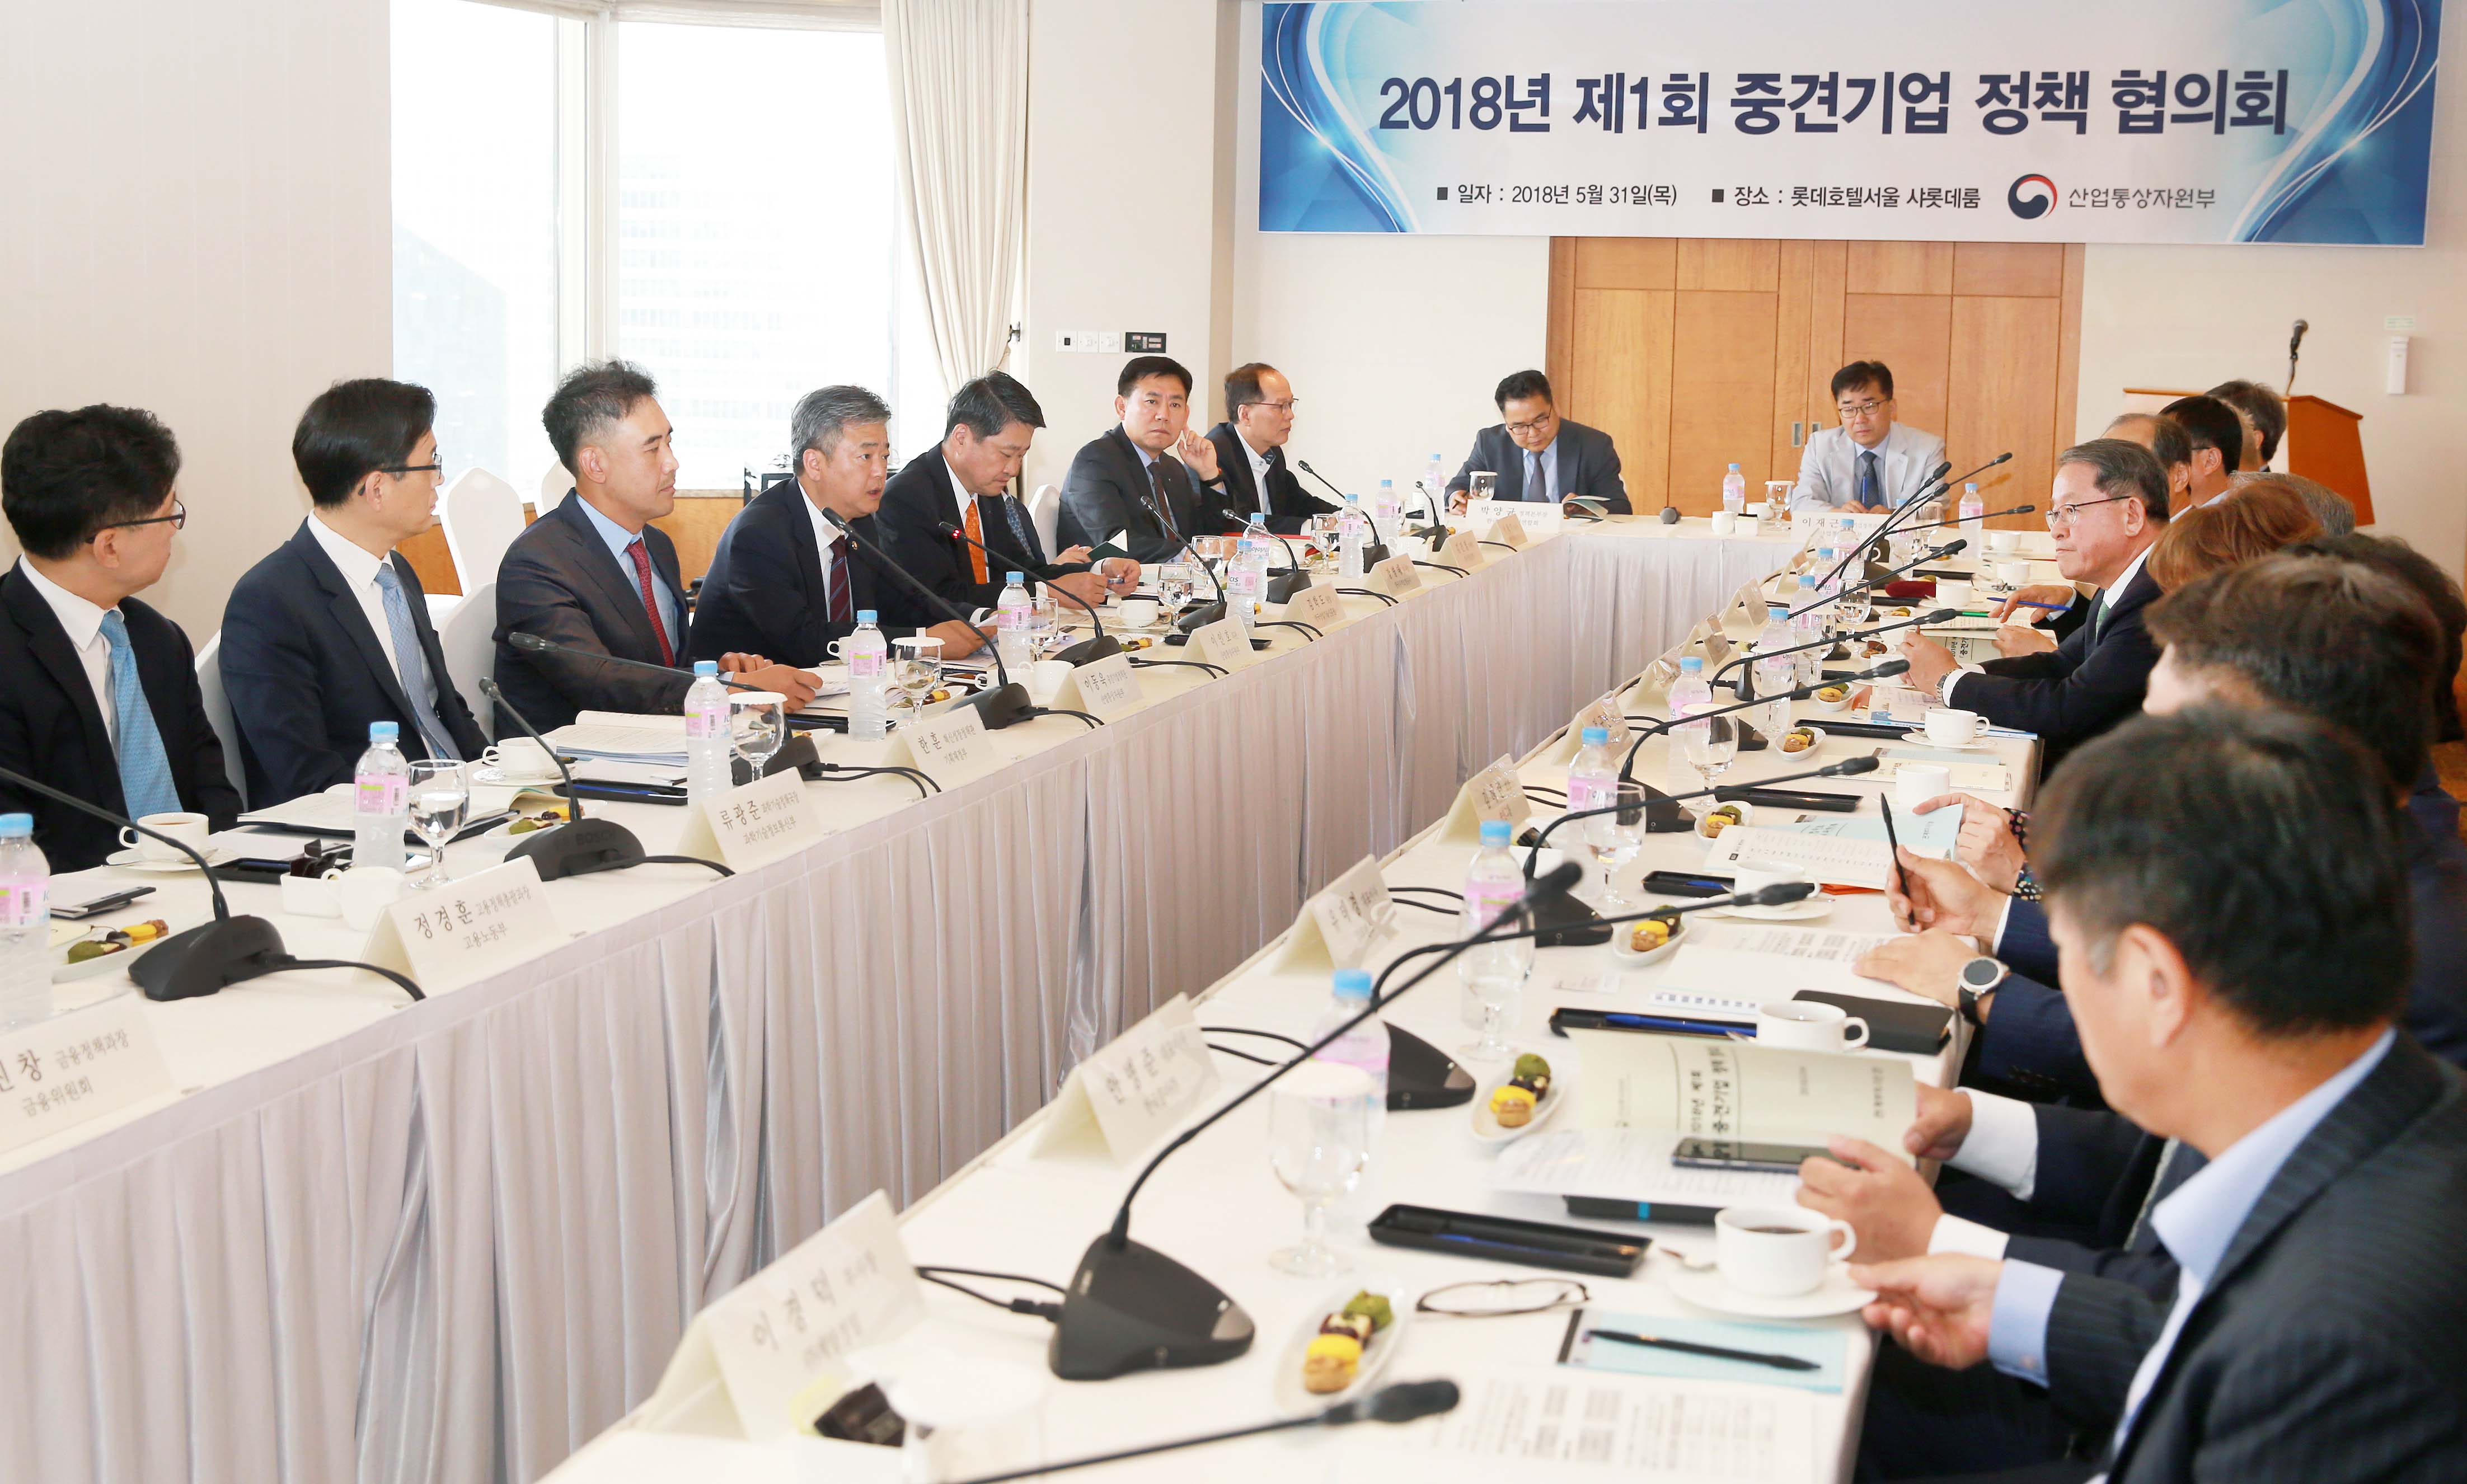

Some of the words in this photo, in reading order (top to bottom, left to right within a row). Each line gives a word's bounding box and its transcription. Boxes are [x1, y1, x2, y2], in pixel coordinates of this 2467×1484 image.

[1379, 73, 1550, 132] 2018년
[1573, 72, 1709, 134] 제1회
[1730, 72, 1950, 135] 중견기업
[1975, 71, 2089, 135] 정책
[2111, 69, 2288, 135] 협의회
[1457, 184, 1492, 204] 일자
[1512, 184, 1569, 204] 2018년
[1576, 185, 1603, 205] 5월
[1609, 184, 1677, 206] 31일(목)
[1734, 186, 1770, 206] 장소
[1790, 186, 1900, 208] 롯데호텔서울
[1906, 187, 1981, 209] 샤롯데룸
[2069, 188, 2216, 209] 산업통상자원부
[720, 800, 761, 831] 류광준
[414, 899, 473, 940] 정경훈
[463, 921, 508, 949] 고용노동부
[55, 1029, 129, 1070] 금융정책과장
[22, 1076, 94, 1117] 금융위원회
